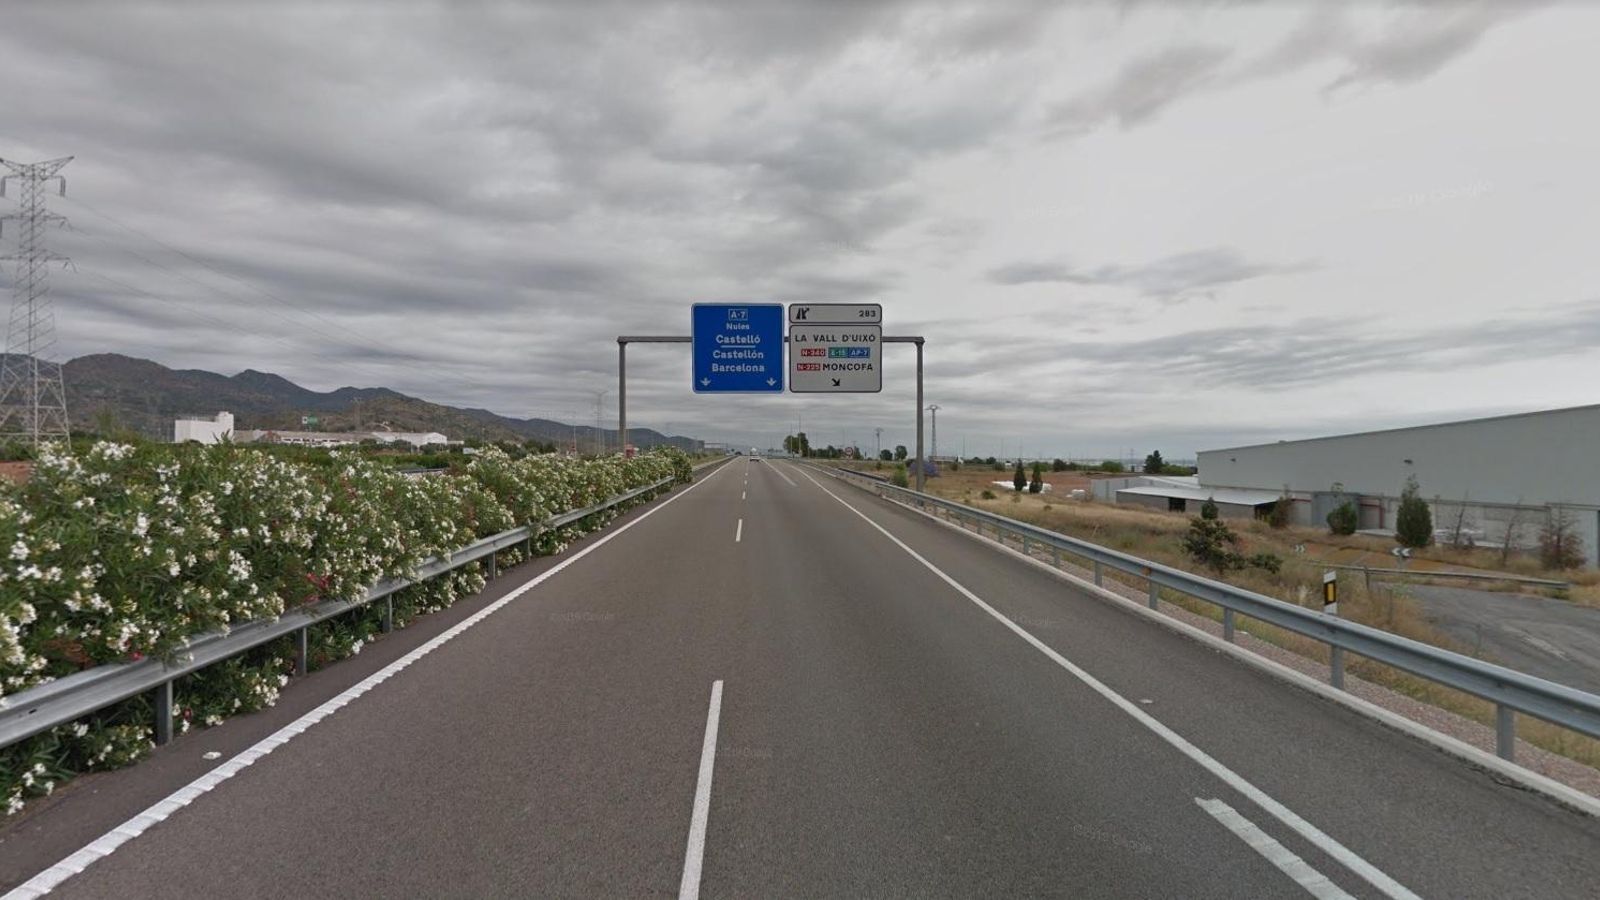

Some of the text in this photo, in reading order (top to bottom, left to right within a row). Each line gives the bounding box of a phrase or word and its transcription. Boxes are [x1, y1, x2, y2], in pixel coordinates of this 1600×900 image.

[715, 334, 761, 344] Castelló
[795, 334, 807, 342] LA
[813, 334, 838, 342] VALL
[712, 350, 764, 359] Castellón
[711, 363, 765, 372] Barcelona
